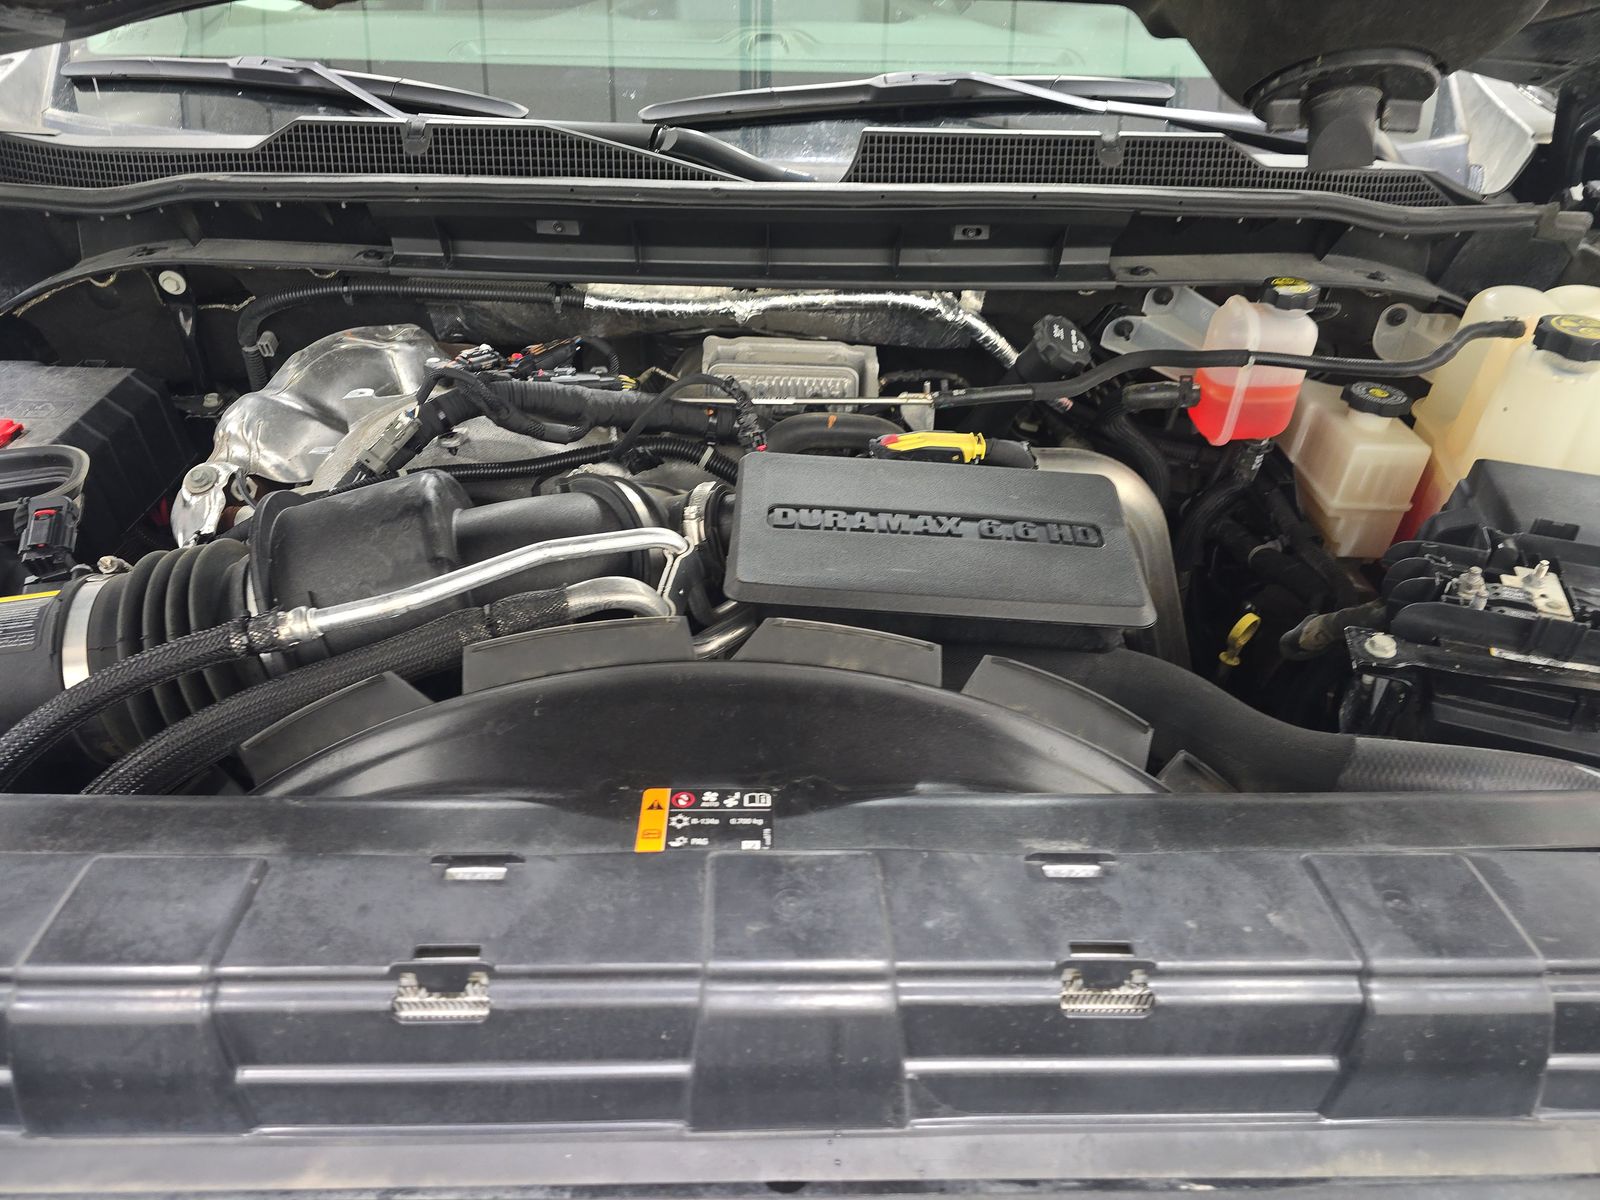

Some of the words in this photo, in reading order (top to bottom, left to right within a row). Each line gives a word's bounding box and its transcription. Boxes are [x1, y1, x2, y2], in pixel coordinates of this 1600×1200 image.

[771, 506, 963, 537] DURAMAX
[978, 518, 1039, 542] 6.6
[1046, 523, 1103, 548] HD
